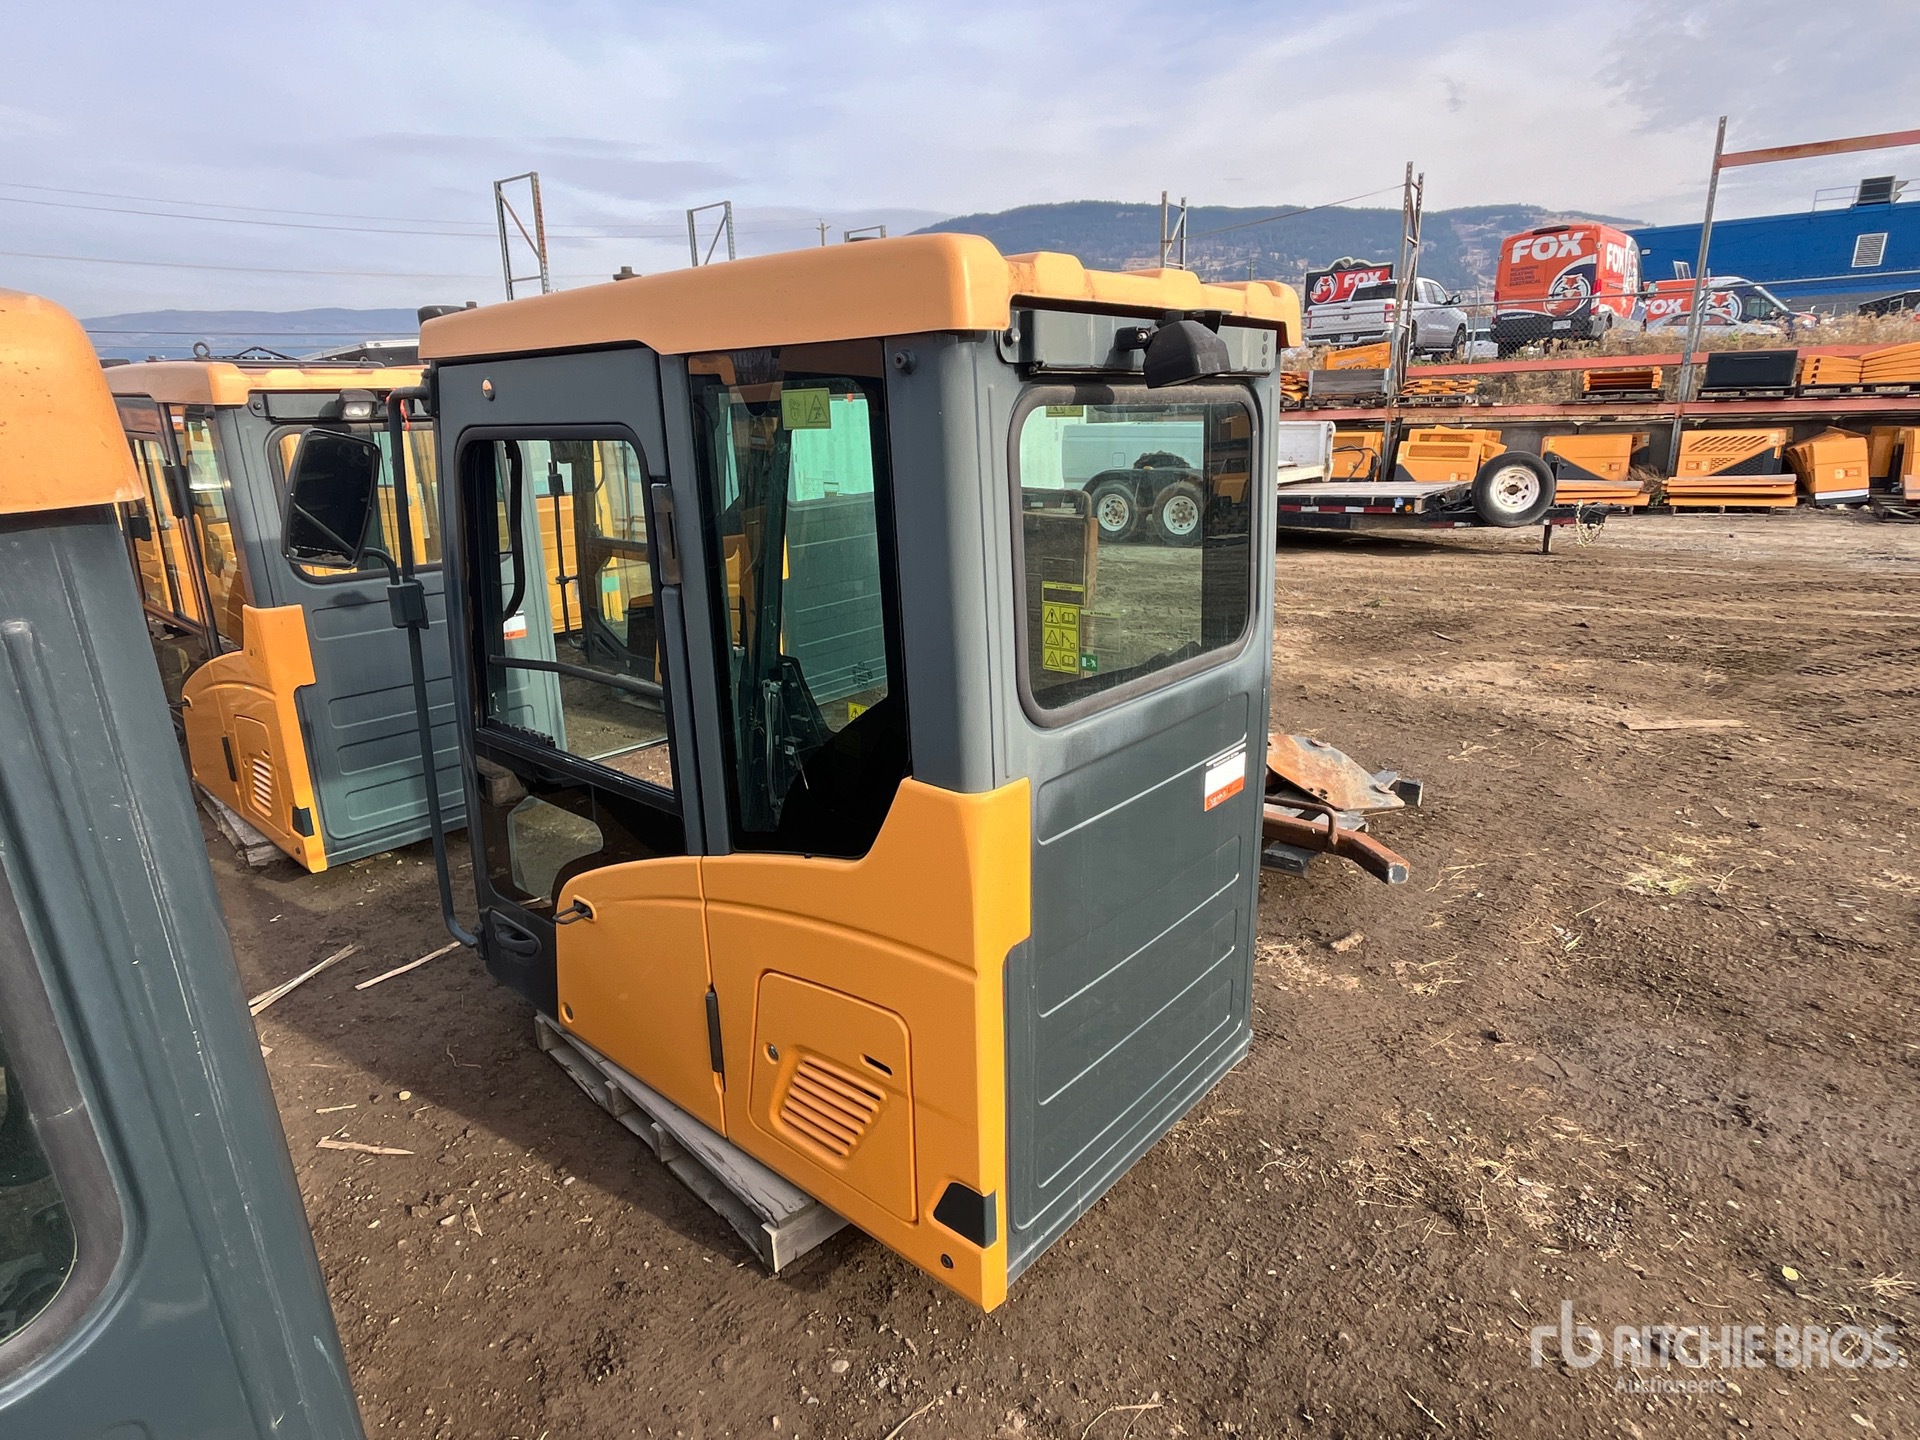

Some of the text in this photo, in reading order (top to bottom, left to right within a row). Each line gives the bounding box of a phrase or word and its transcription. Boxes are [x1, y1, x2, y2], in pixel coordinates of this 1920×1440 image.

[1511, 232, 1584, 264] FOX
[1606, 242, 1626, 274] FOX
[1343, 271, 1381, 288] FOX
